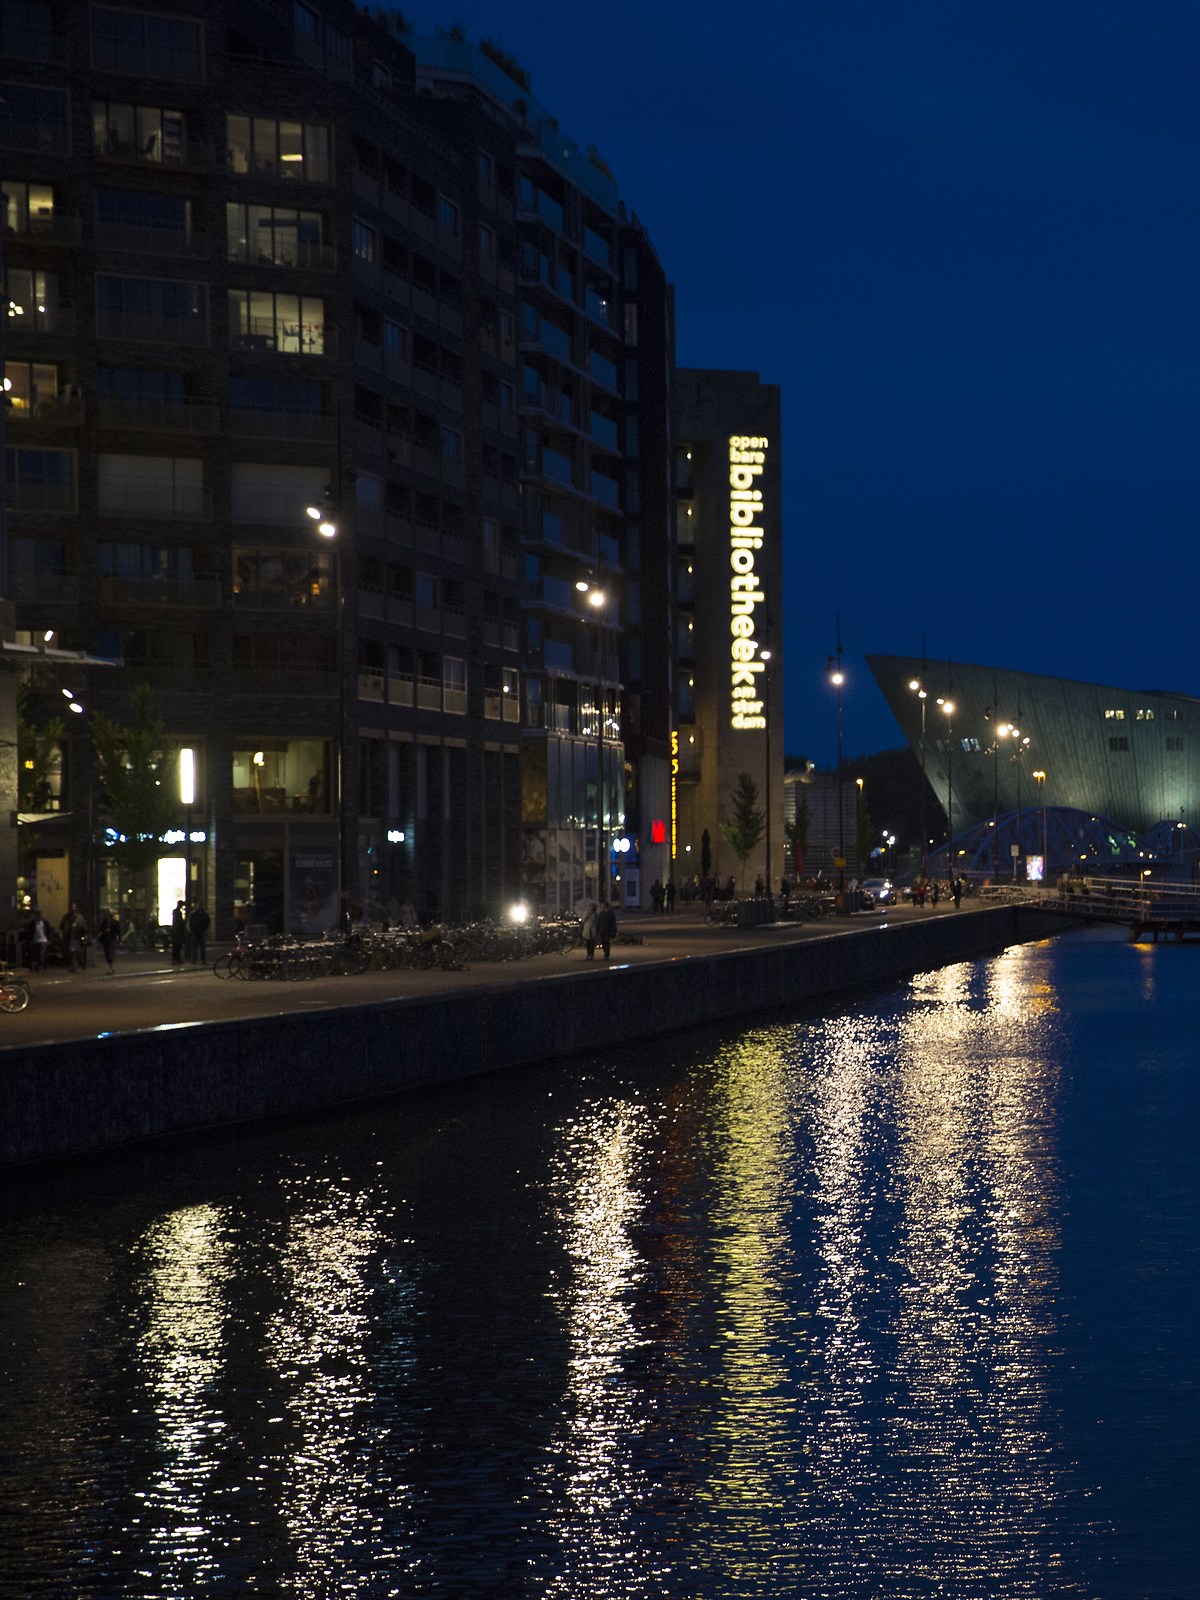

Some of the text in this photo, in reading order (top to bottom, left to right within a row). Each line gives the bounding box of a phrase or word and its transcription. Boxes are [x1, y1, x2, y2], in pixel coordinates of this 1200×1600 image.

[730, 436, 769, 450] open
[730, 447, 766, 464] bare
[730, 464, 765, 685] bibliotheek
